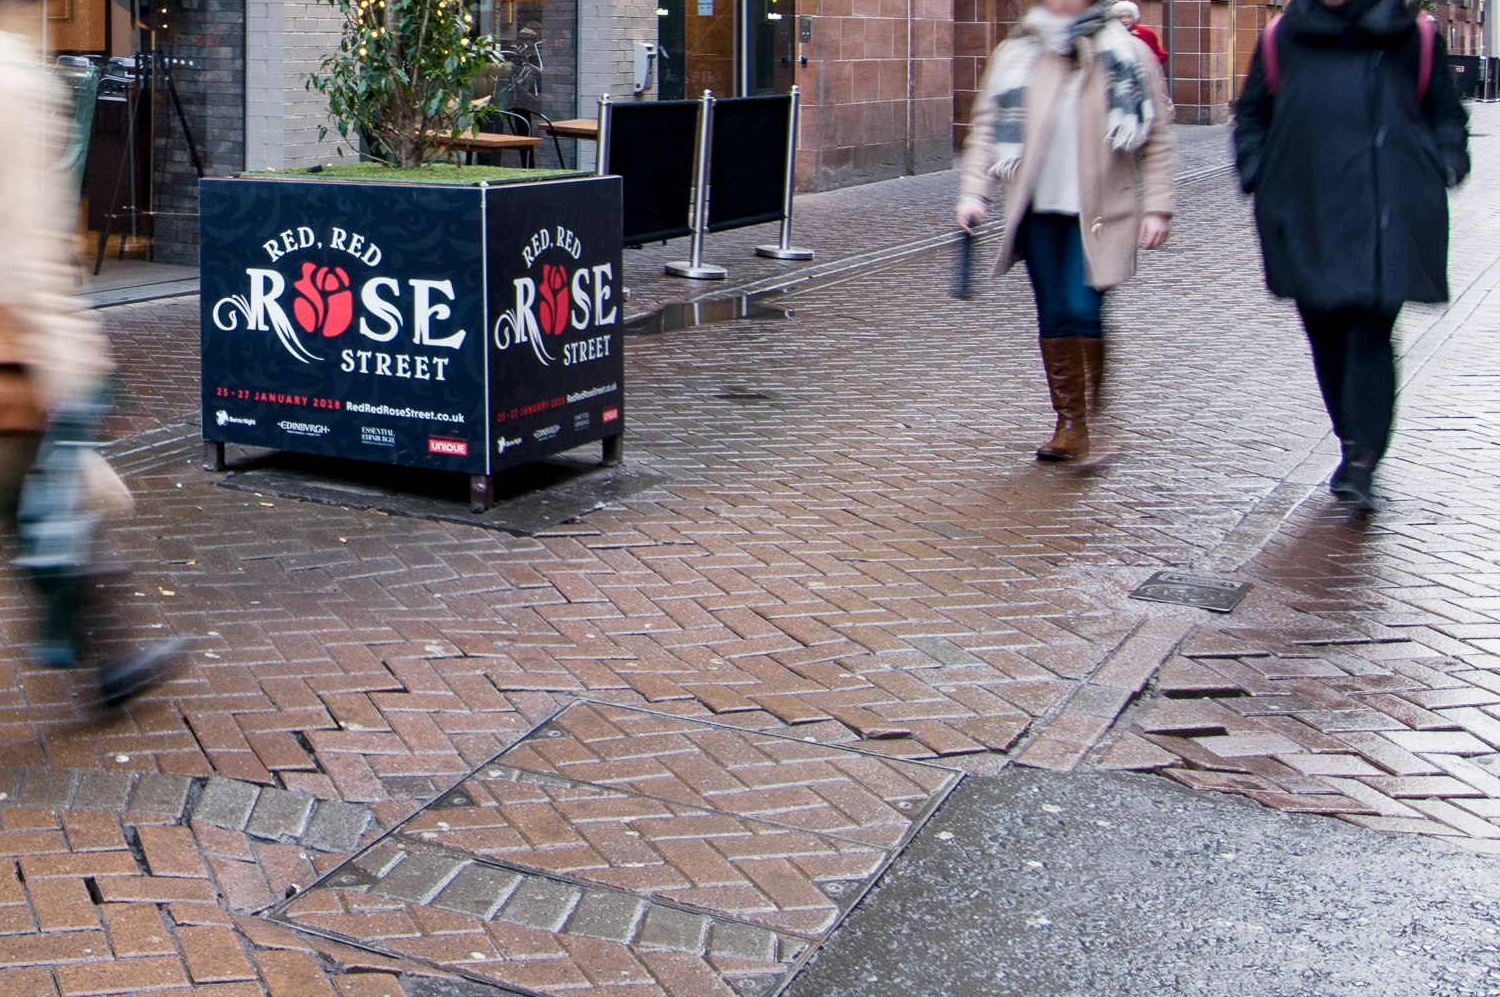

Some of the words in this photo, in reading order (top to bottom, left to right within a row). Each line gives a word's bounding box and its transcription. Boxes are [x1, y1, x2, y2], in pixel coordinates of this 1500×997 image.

[262, 226, 322, 262] RED,
[330, 227, 382, 267] RED
[522, 228, 554, 269] RED,
[556, 225, 581, 260] RED
[340, 349, 450, 381] STREET
[563, 335, 611, 366] STREET
[254, 392, 308, 406] JANUARY
[313, 398, 341, 410] 2018
[346, 401, 465, 423] RedRedRoseStreet.co.uk
